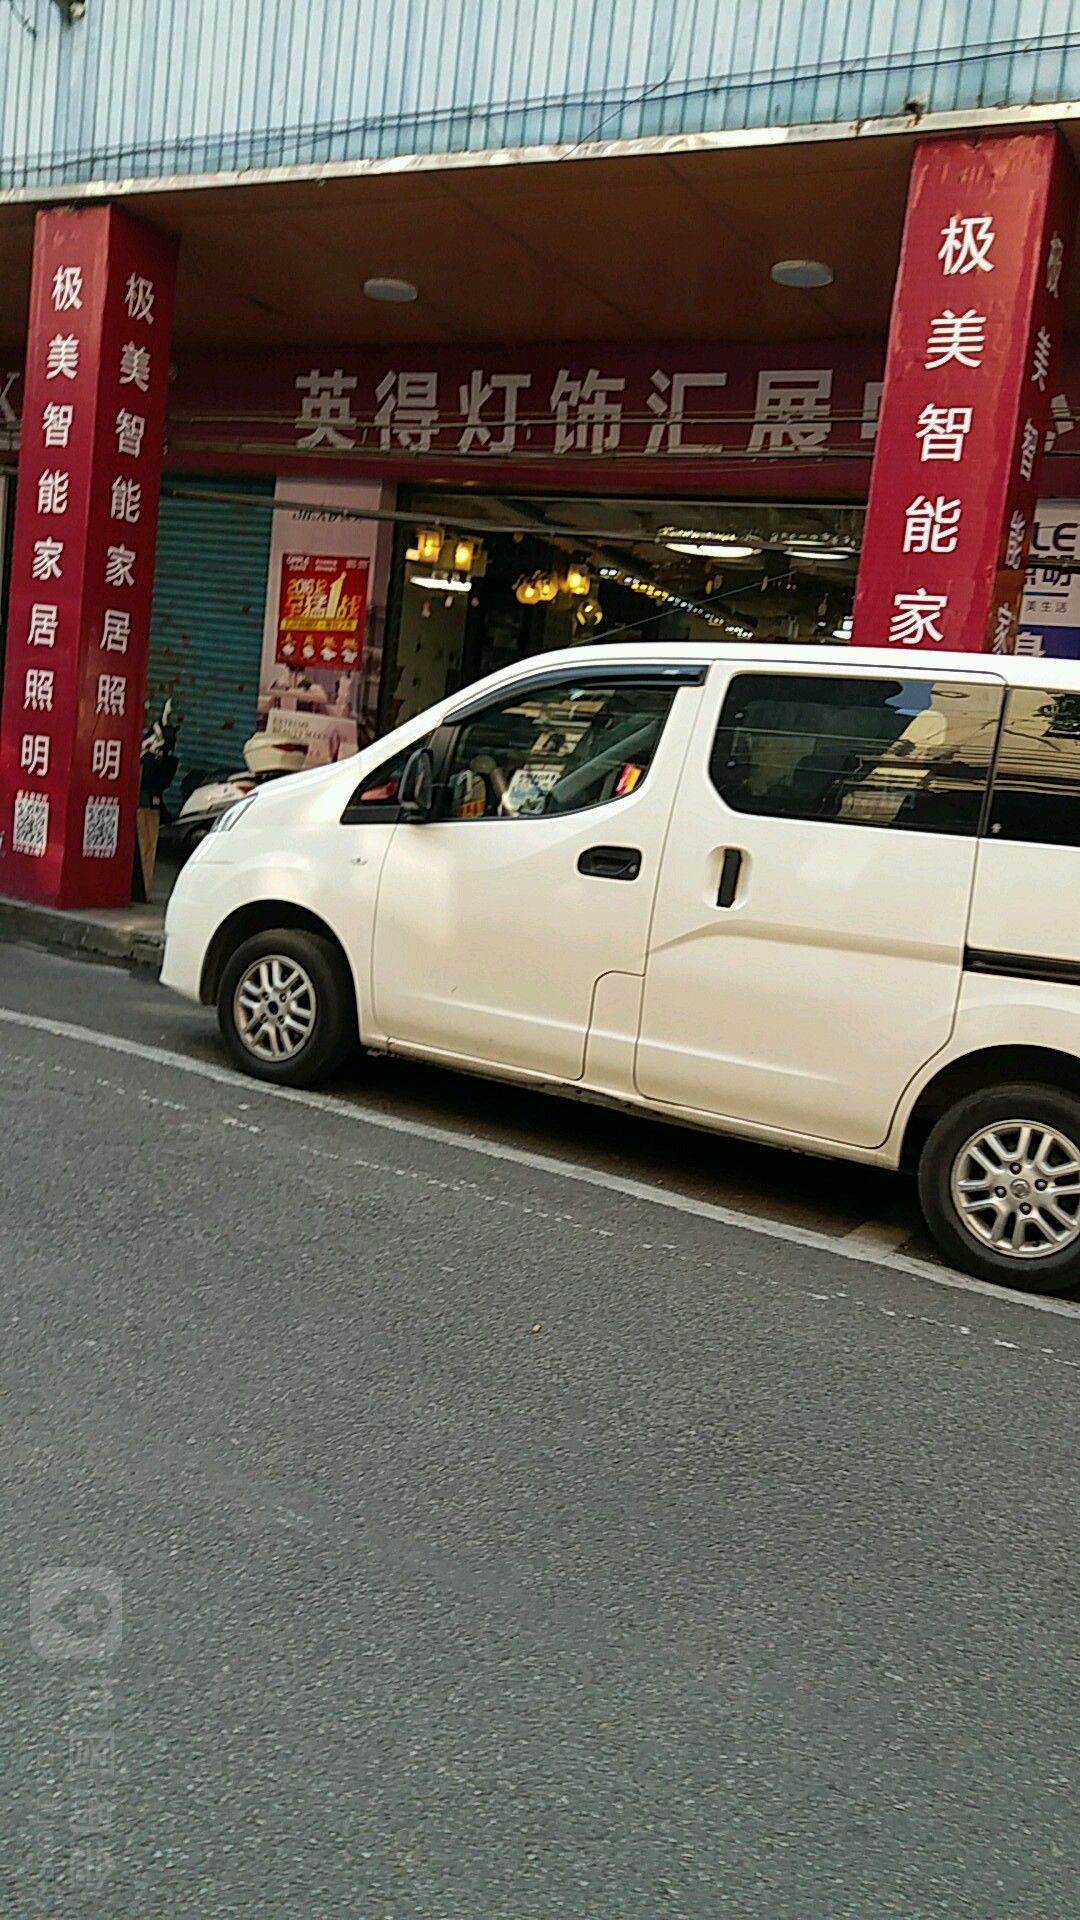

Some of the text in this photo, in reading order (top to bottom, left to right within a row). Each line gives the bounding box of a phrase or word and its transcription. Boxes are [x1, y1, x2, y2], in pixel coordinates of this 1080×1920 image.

[20, 265, 84, 777] 极美智能家居照明
[92, 272, 155, 780] 极美智能家居照明
[888, 215, 995, 645] 极美智能家
